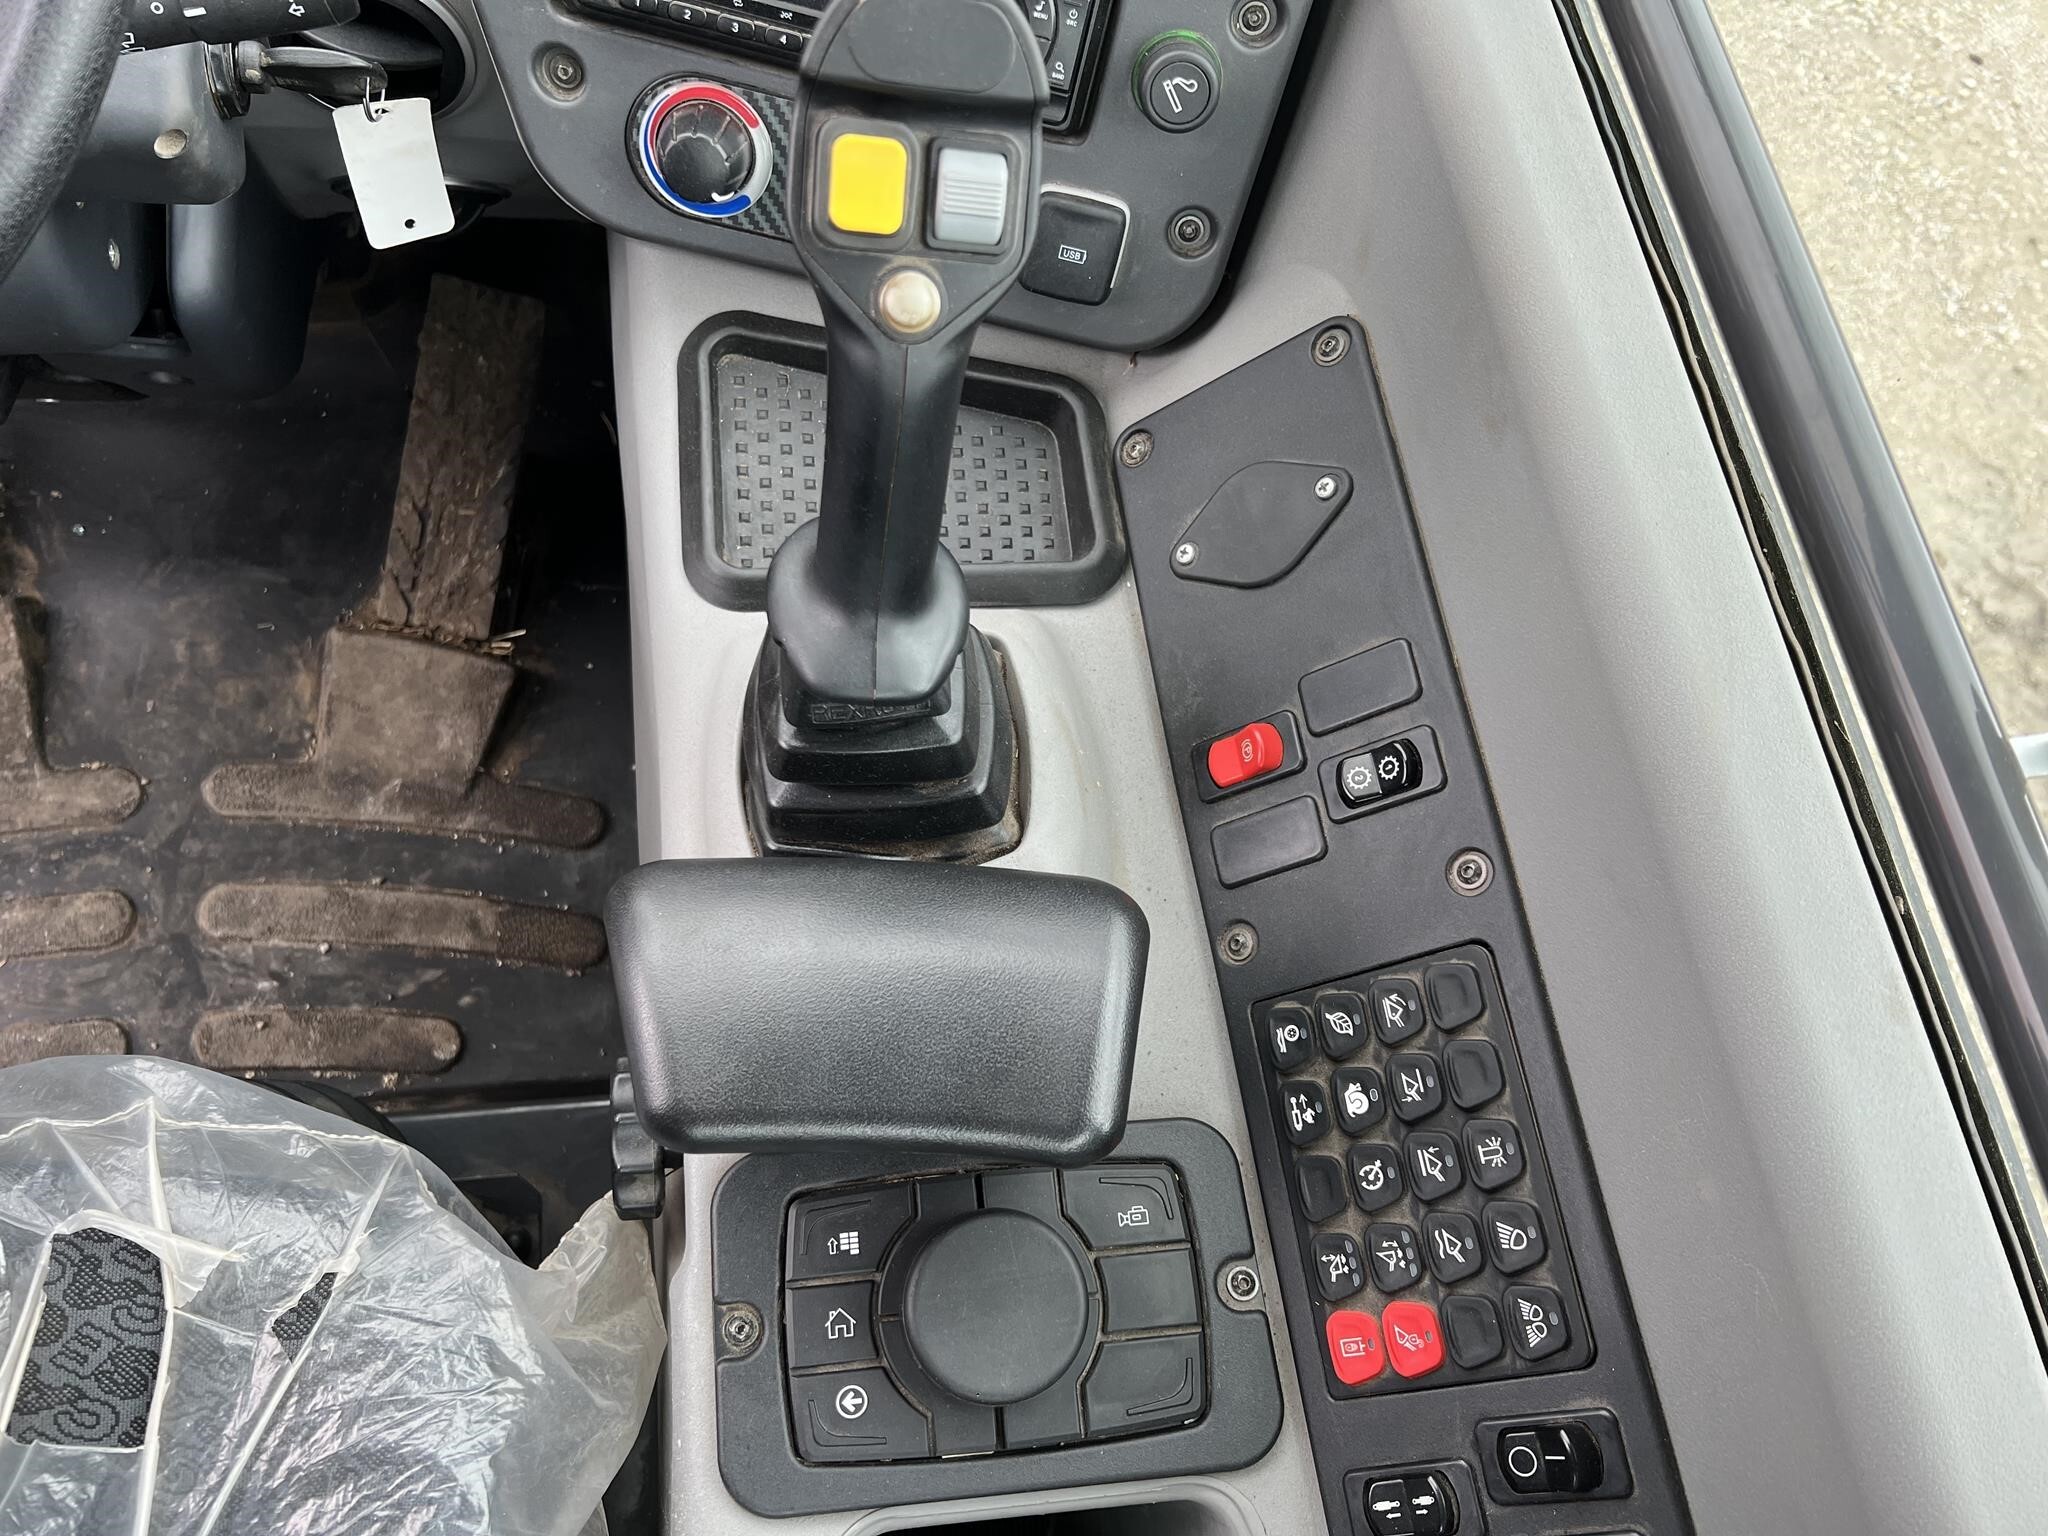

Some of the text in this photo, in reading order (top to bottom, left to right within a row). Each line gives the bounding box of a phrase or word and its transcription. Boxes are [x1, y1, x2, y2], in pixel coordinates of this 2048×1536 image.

[684, 9, 692, 20] 2
[731, 22, 739, 33] 3
[780, 34, 787, 45] 4
[1063, 248, 1081, 260] USB
